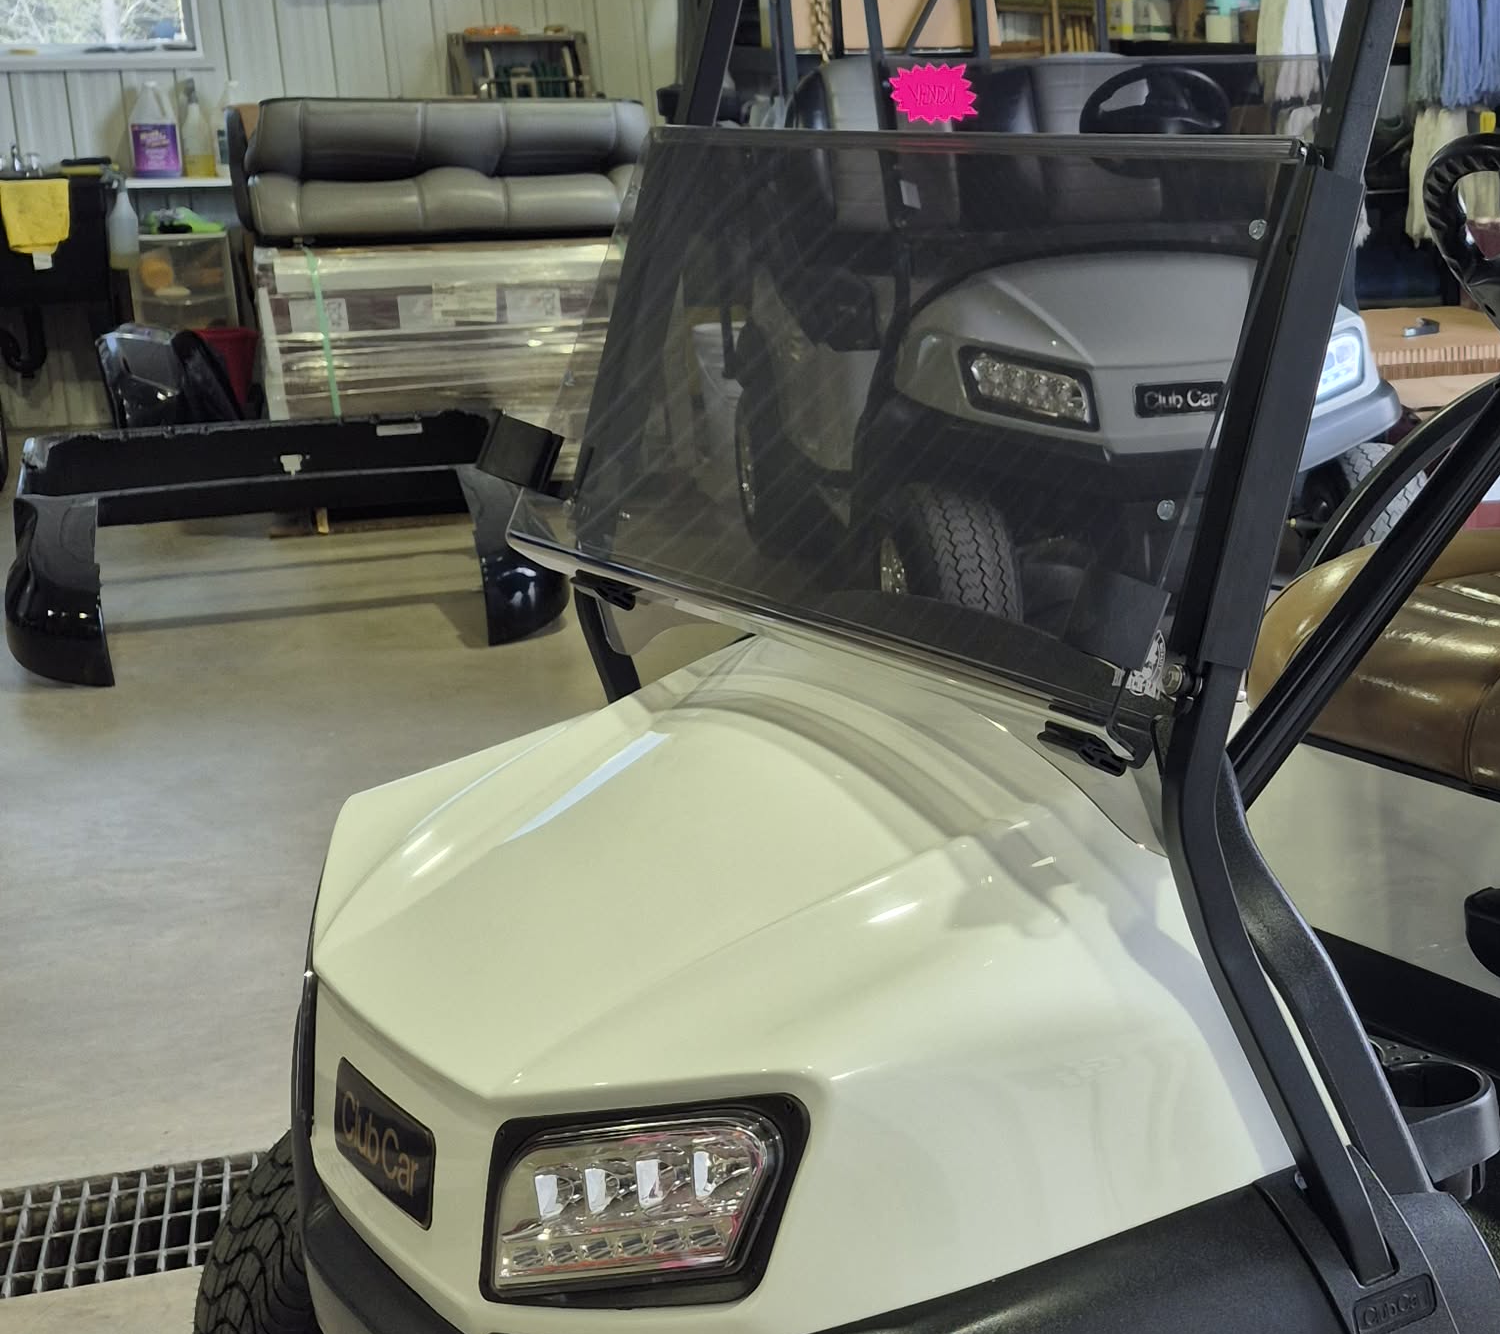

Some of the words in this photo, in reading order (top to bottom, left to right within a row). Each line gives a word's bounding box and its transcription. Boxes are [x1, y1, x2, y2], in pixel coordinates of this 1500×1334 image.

[1144, 390, 1184, 409] Club
[1187, 388, 1218, 407] Car
[342, 1091, 379, 1164] Club
[381, 1128, 419, 1197] Car
